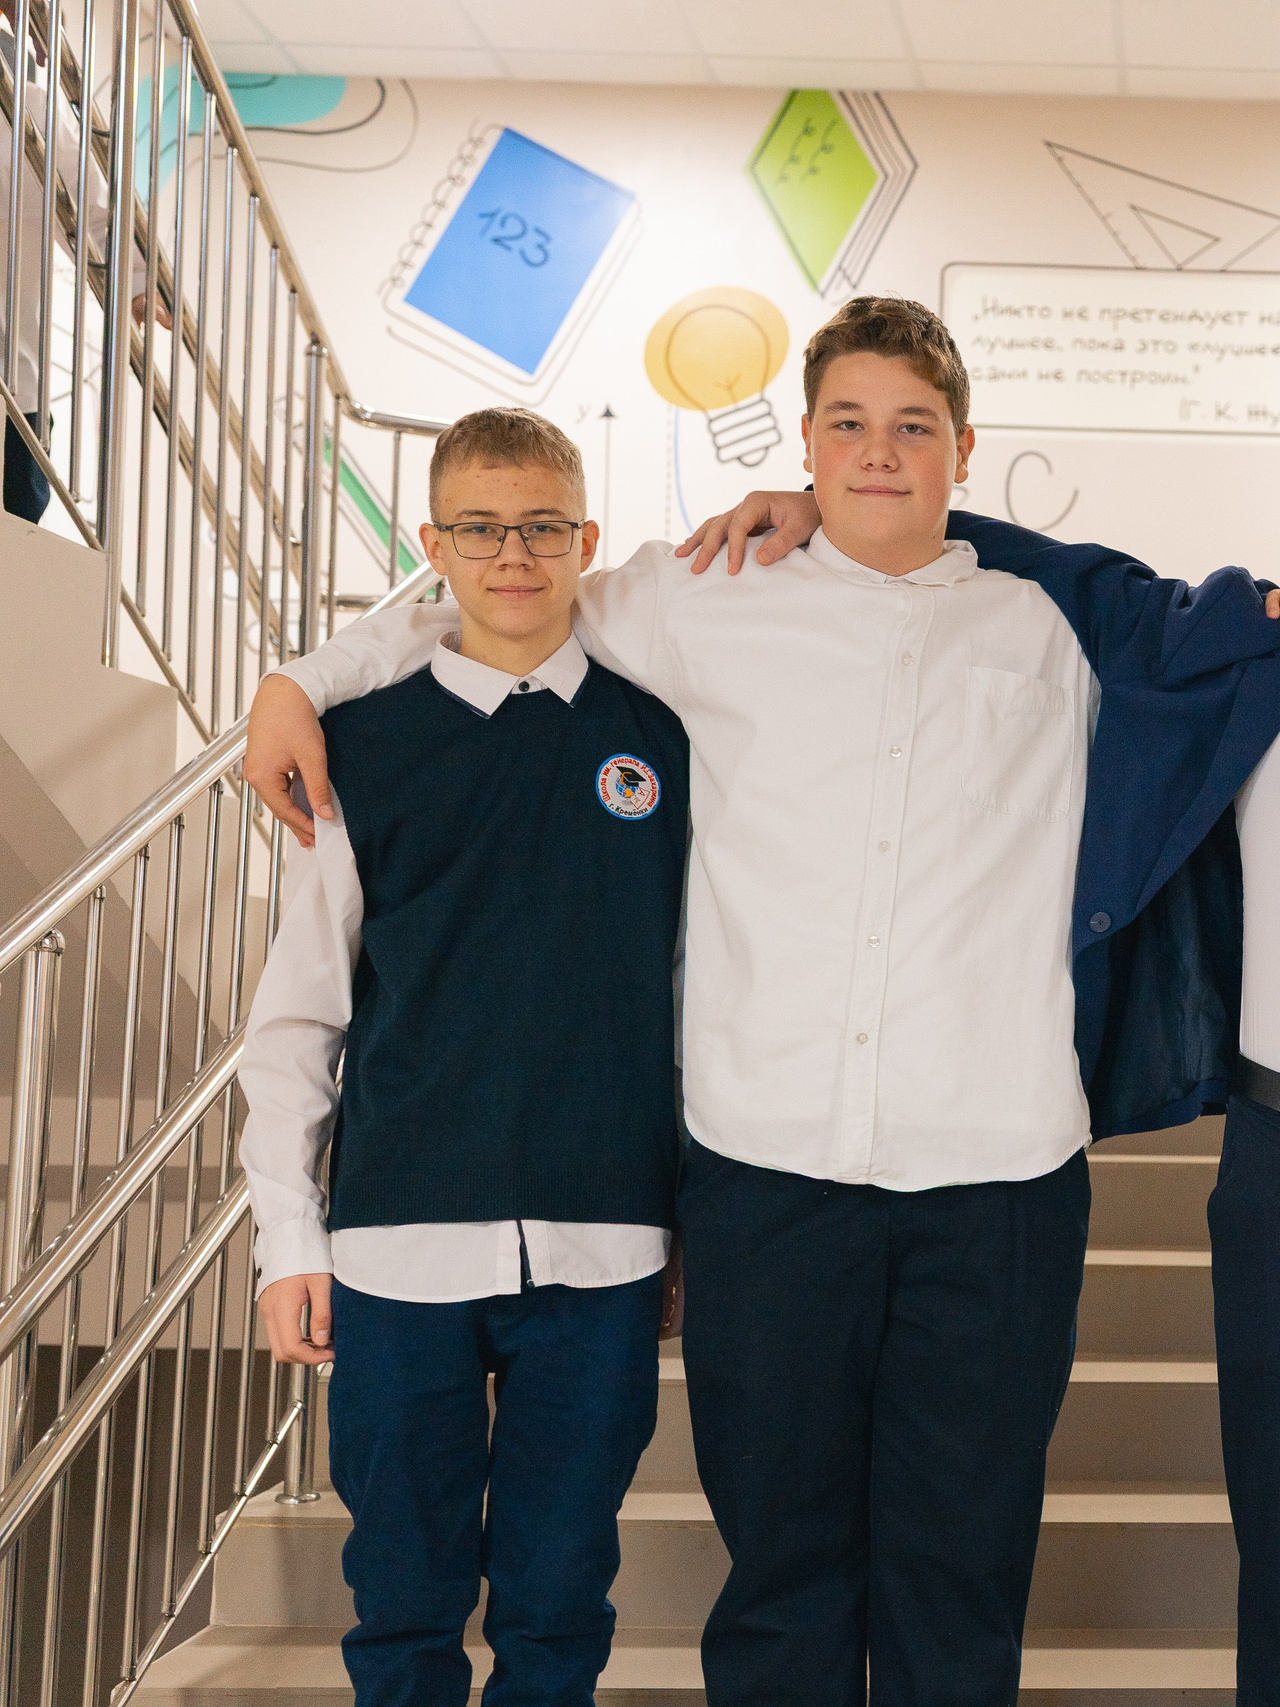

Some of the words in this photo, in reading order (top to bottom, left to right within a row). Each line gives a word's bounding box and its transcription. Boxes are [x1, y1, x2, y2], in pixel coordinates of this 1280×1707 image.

[478, 207, 553, 268] 123
[1061, 306, 1091, 322] не
[1099, 306, 1249, 332] претендует
[1071, 337, 1126, 352] пока
[1136, 338, 1178, 354] это
[1036, 368, 1066, 382] не
[600, 778, 611, 803] Школа
[610, 757, 640, 768] генерала
